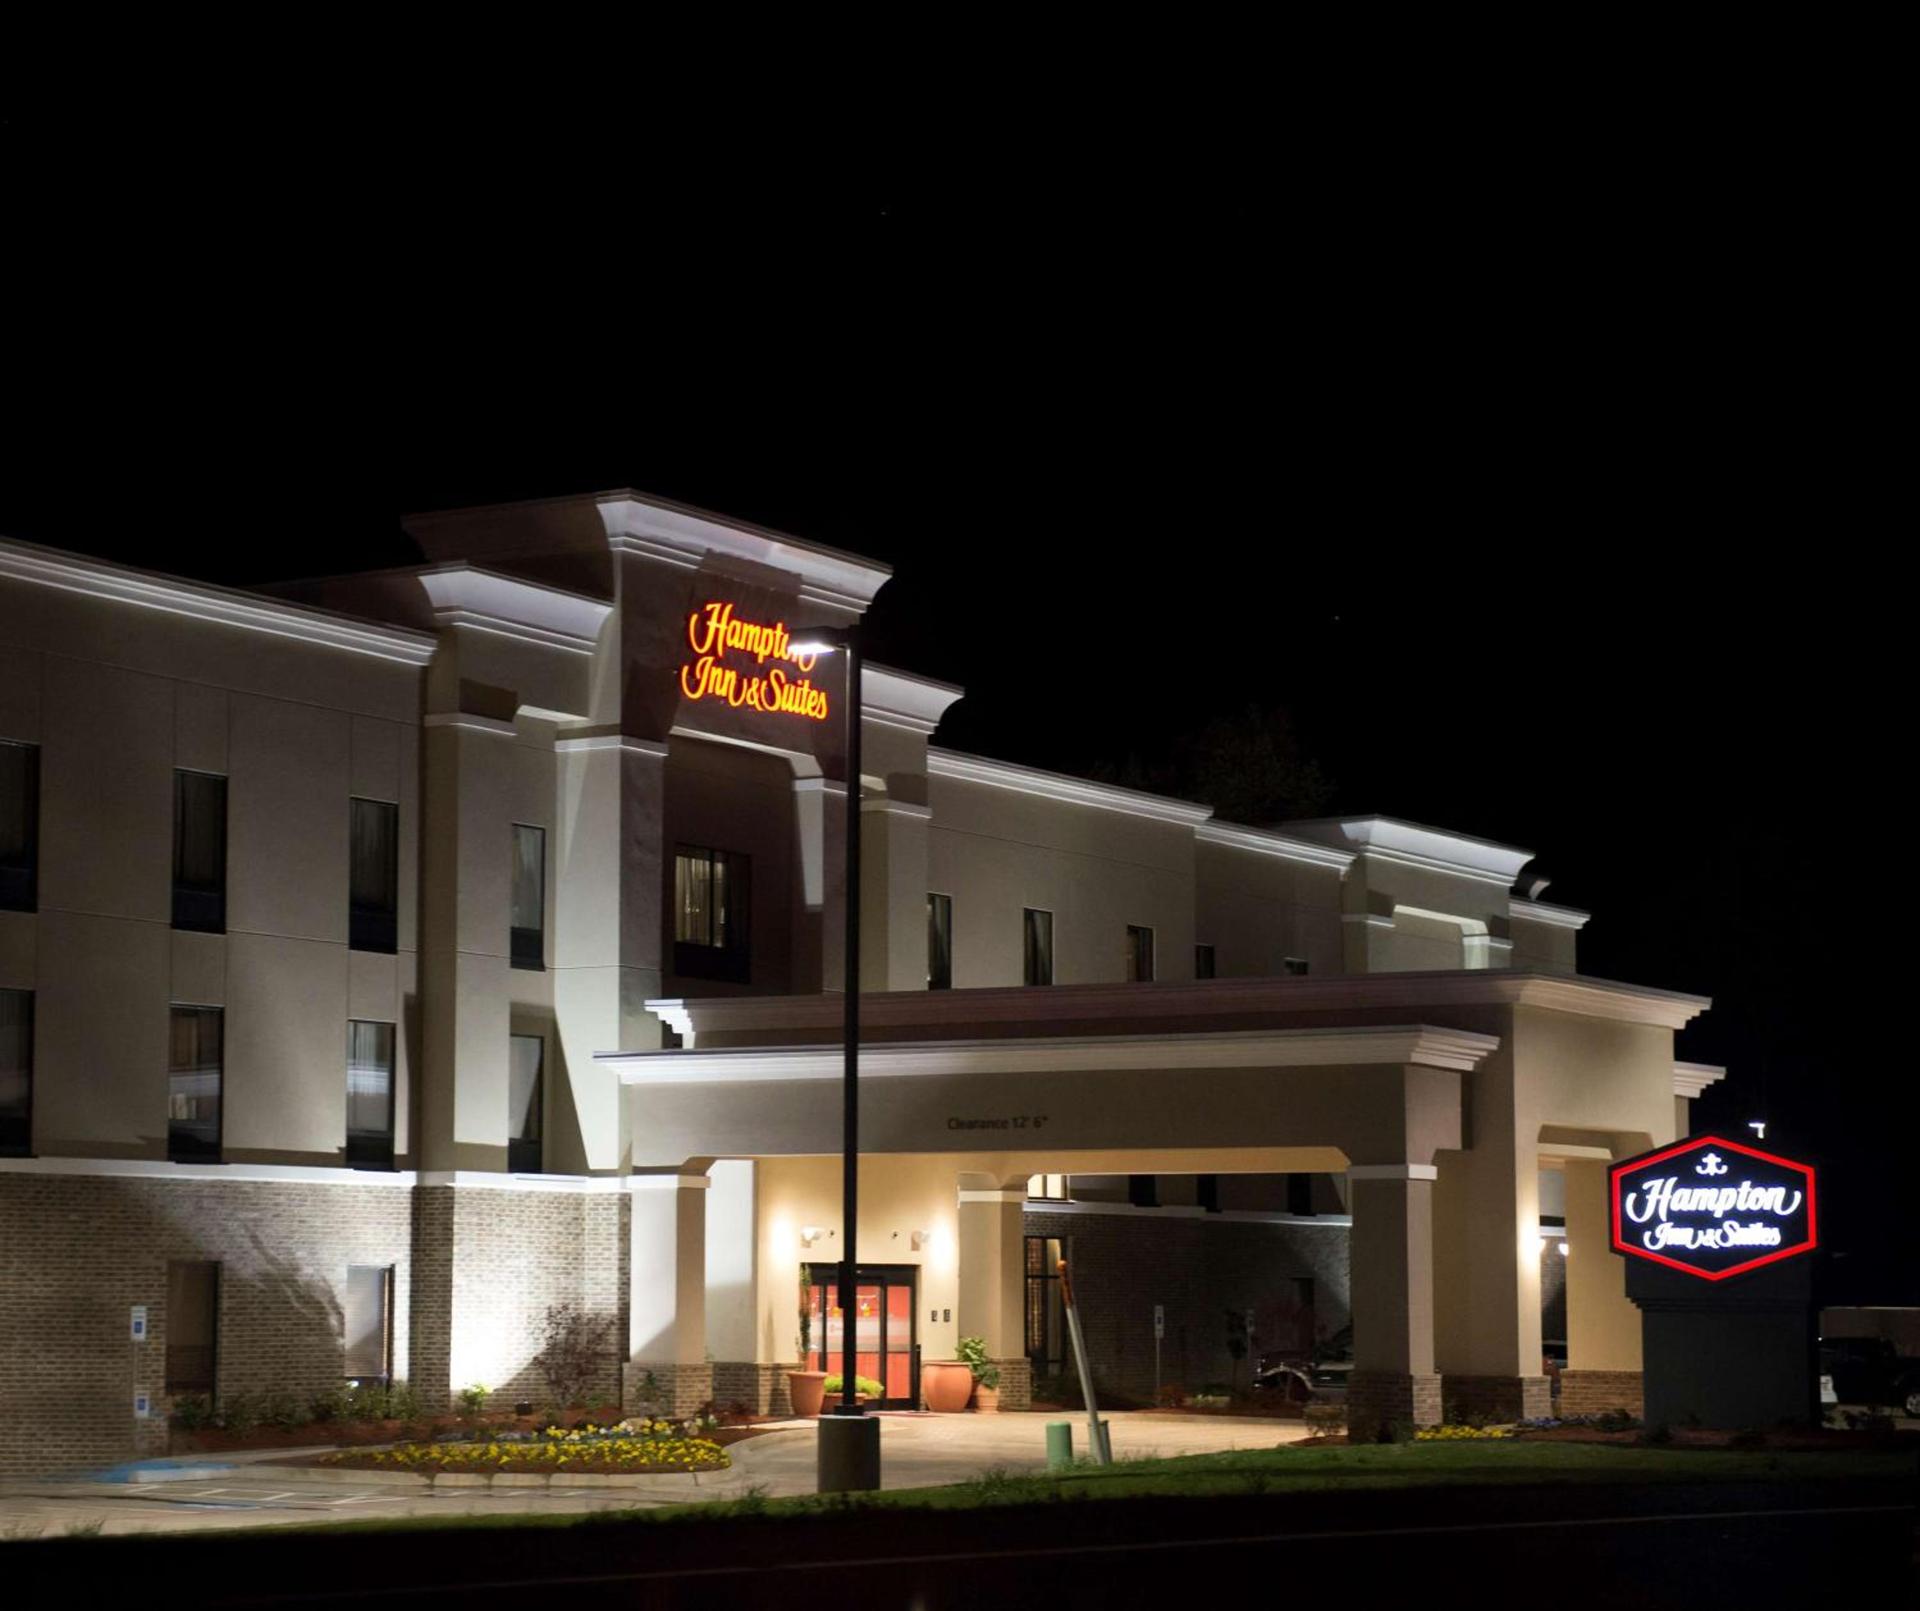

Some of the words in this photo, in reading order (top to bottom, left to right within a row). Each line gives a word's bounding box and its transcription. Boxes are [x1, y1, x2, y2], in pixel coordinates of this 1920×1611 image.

[681, 656, 748, 707] Inn
[746, 677, 764, 711] &
[760, 669, 828, 720] Suites
[947, 1117, 1008, 1130] Clearance
[1625, 1177, 1802, 1223] Hampton
[1643, 1222, 1701, 1250] Inn
[1700, 1229, 1719, 1249] &
[1715, 1220, 1781, 1248] Suites
